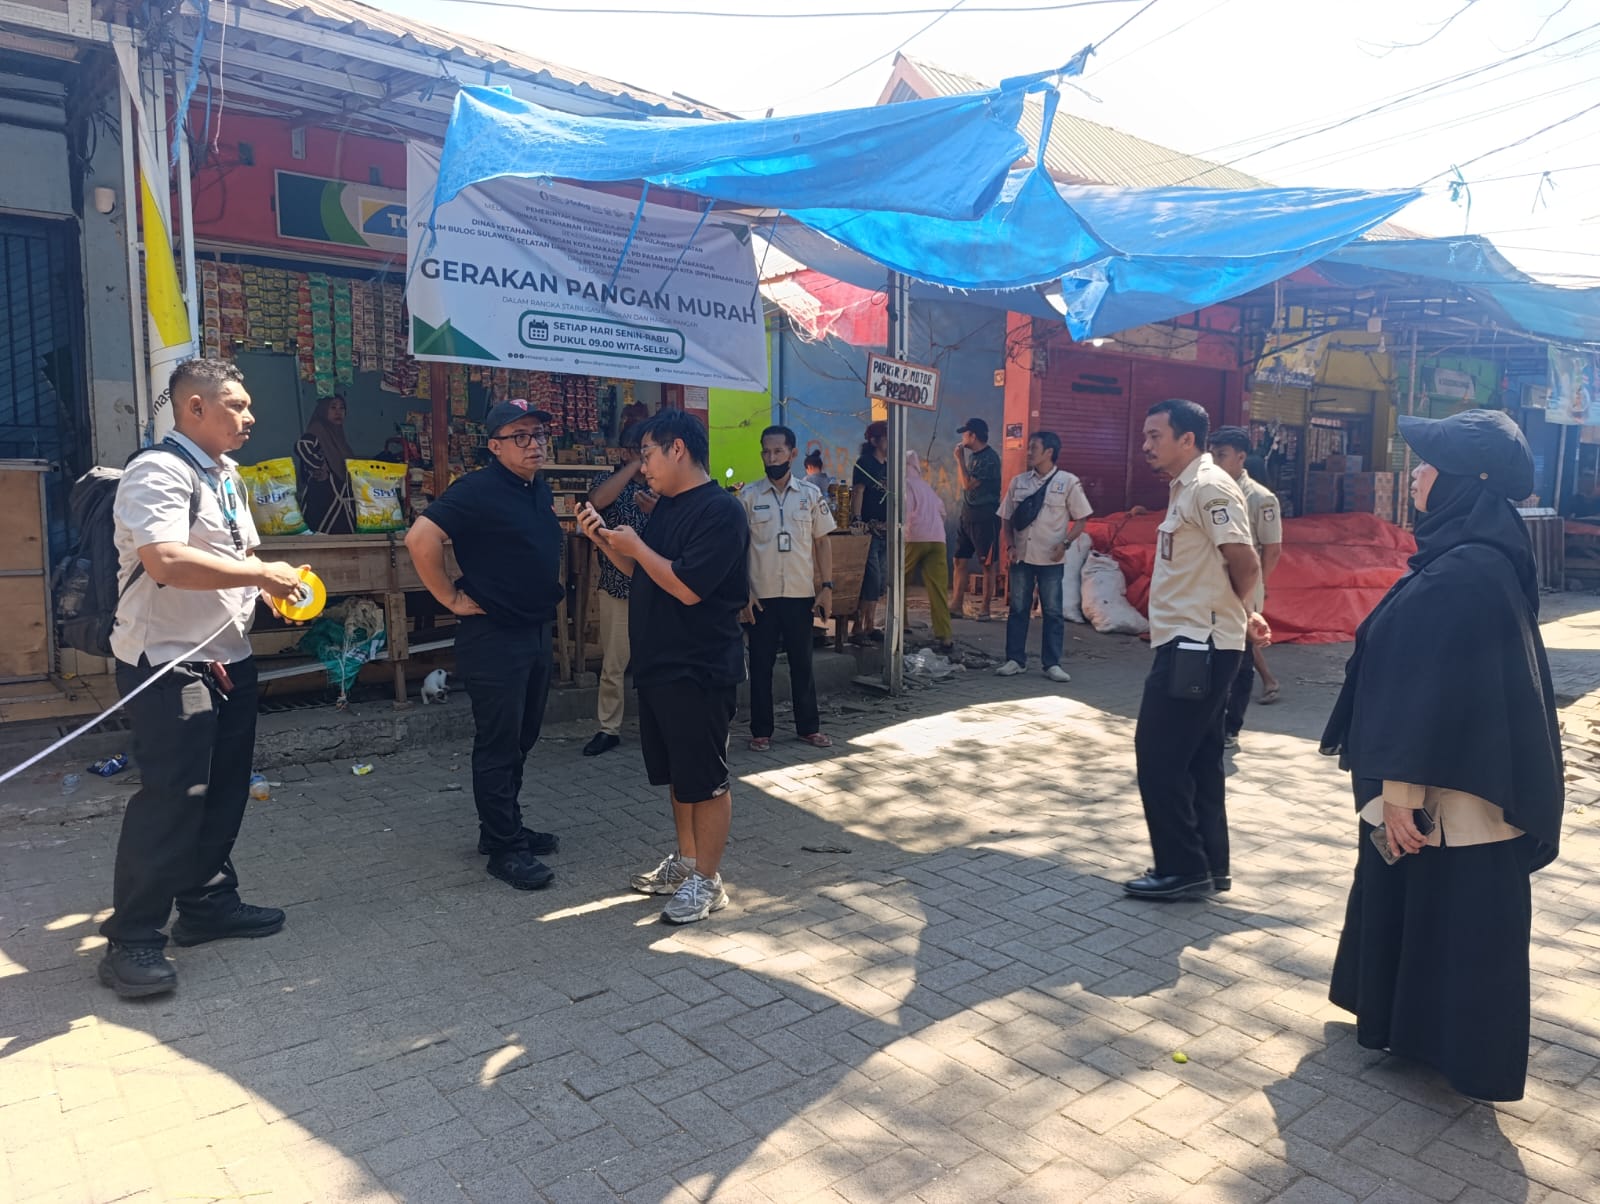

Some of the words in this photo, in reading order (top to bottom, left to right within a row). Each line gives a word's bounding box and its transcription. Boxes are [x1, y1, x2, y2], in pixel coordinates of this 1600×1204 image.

[417, 221, 446, 231] PEUM
[448, 226, 476, 236] BULOG
[477, 229, 515, 242] SULAWESI
[517, 237, 549, 248] SELATAN
[472, 218, 496, 229] DINAS
[420, 258, 558, 294] GERAKAN
[565, 278, 671, 311] PANGAN
[678, 295, 757, 325] MURAH
[502, 296, 528, 305] DALAM
[530, 300, 560, 309] RANGKA
[553, 321, 588, 332] SETIAP
[590, 325, 613, 336] HARI
[615, 329, 669, 344] SENIN-RABU
[553, 334, 587, 346] PUKUL
[588, 338, 614, 349] 09.00
[616, 341, 678, 356] WITA-SELESAI
[910, 369, 933, 386] MOTOR
